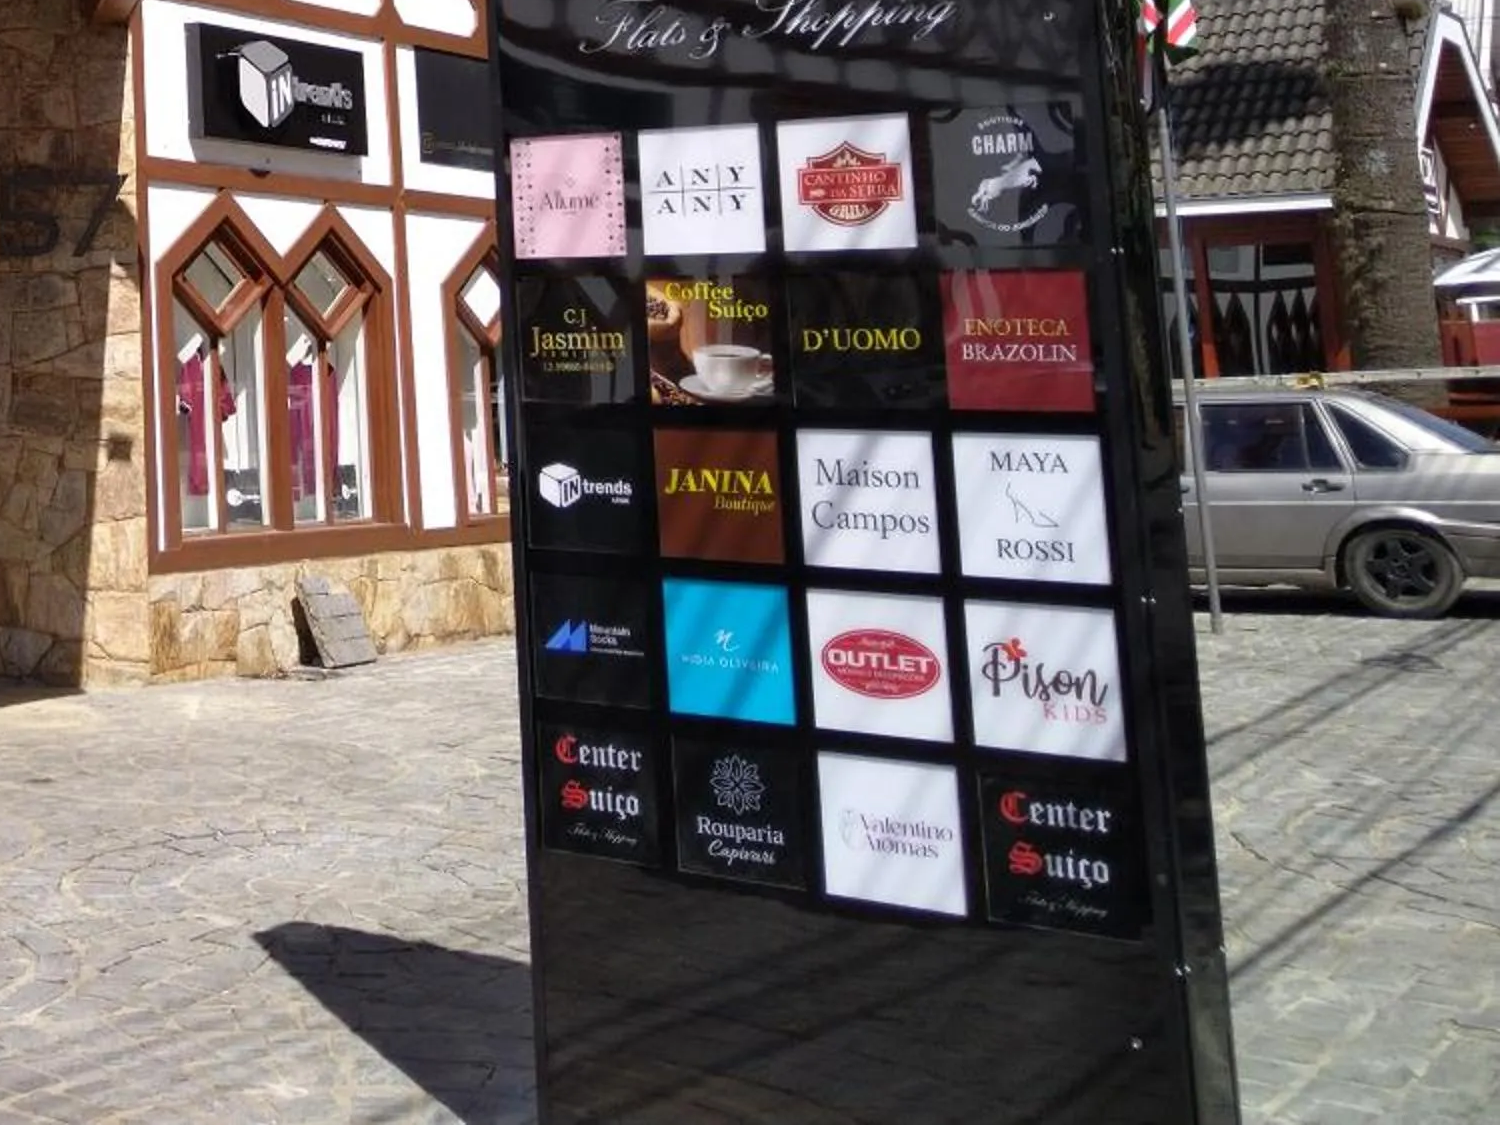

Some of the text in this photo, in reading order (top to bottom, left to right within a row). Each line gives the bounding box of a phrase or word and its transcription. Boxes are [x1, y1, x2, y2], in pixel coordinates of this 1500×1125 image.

[971, 132, 1035, 156] CHARM
[803, 169, 888, 187] CANTINHO
[848, 183, 899, 198] SERRA
[828, 203, 874, 220] GRILL
[664, 282, 735, 302] Coffee
[803, 327, 921, 352] D'UOMO
[963, 317, 1073, 336] ENOTECA
[529, 326, 624, 358] Jasmim
[962, 342, 1077, 362] BRAZOLIN
[814, 457, 920, 490] Maison
[990, 450, 1069, 474] MAYA
[582, 477, 633, 497] trends
[664, 467, 774, 495] JANINA
[713, 494, 775, 516] Boutique
[811, 500, 930, 539] Campos
[996, 537, 1075, 563] ROSSI
[827, 648, 934, 674] OUTLET
[981, 641, 1109, 707] Pison
[1042, 701, 1108, 725] KIDS
[555, 733, 642, 772] Center
[561, 779, 640, 820] Suiço
[1000, 791, 1111, 833] Center
[696, 815, 785, 846] Rouparia
[859, 812, 954, 842] Valentino
[1008, 840, 1110, 888] Suiço
